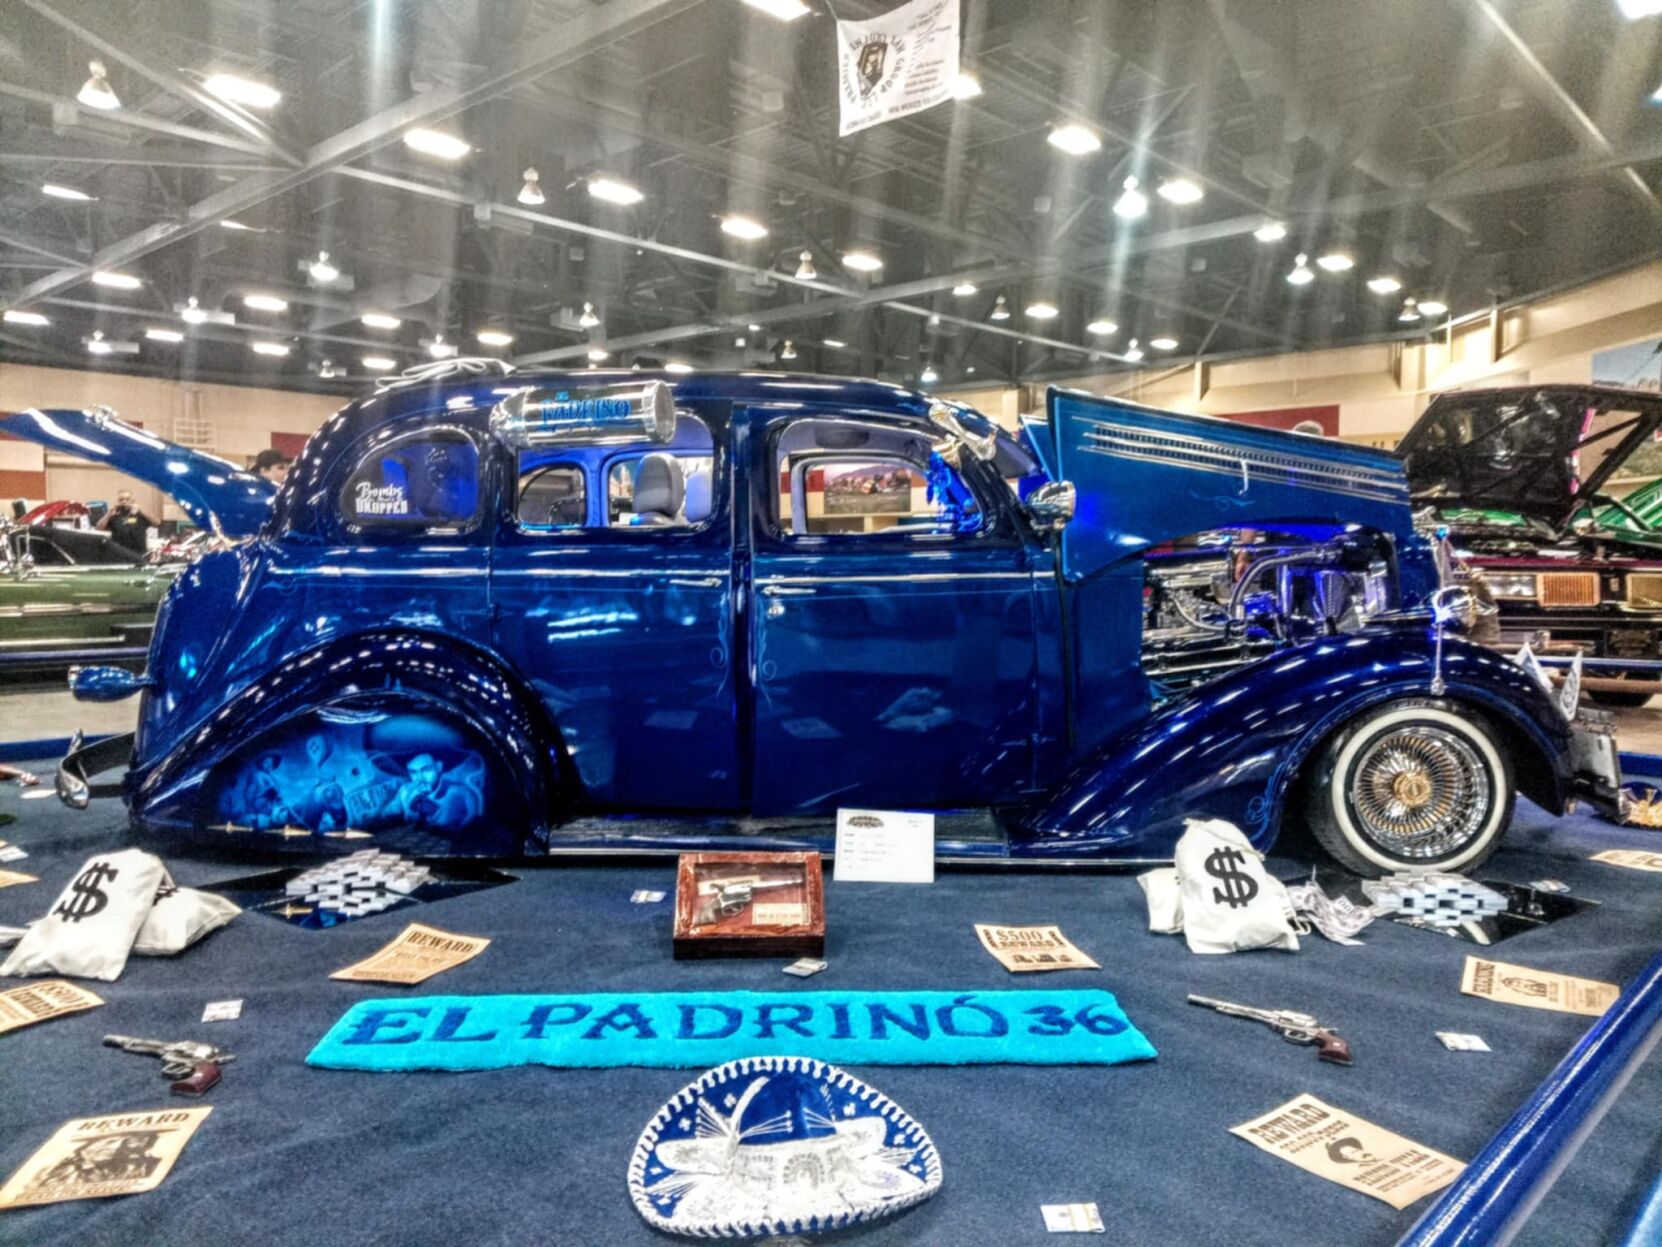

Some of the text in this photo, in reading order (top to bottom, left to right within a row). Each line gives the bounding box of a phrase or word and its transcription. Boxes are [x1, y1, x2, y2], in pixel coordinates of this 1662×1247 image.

[356, 481, 404, 500] Bombs
[407, 931, 477, 953] REWARD
[996, 929, 1043, 941] $500
[342, 1006, 497, 1045] EL
[1022, 1004, 1130, 1037] 36
[78, 1112, 190, 1130] REWARD
[1247, 1103, 1331, 1145] REWARD
